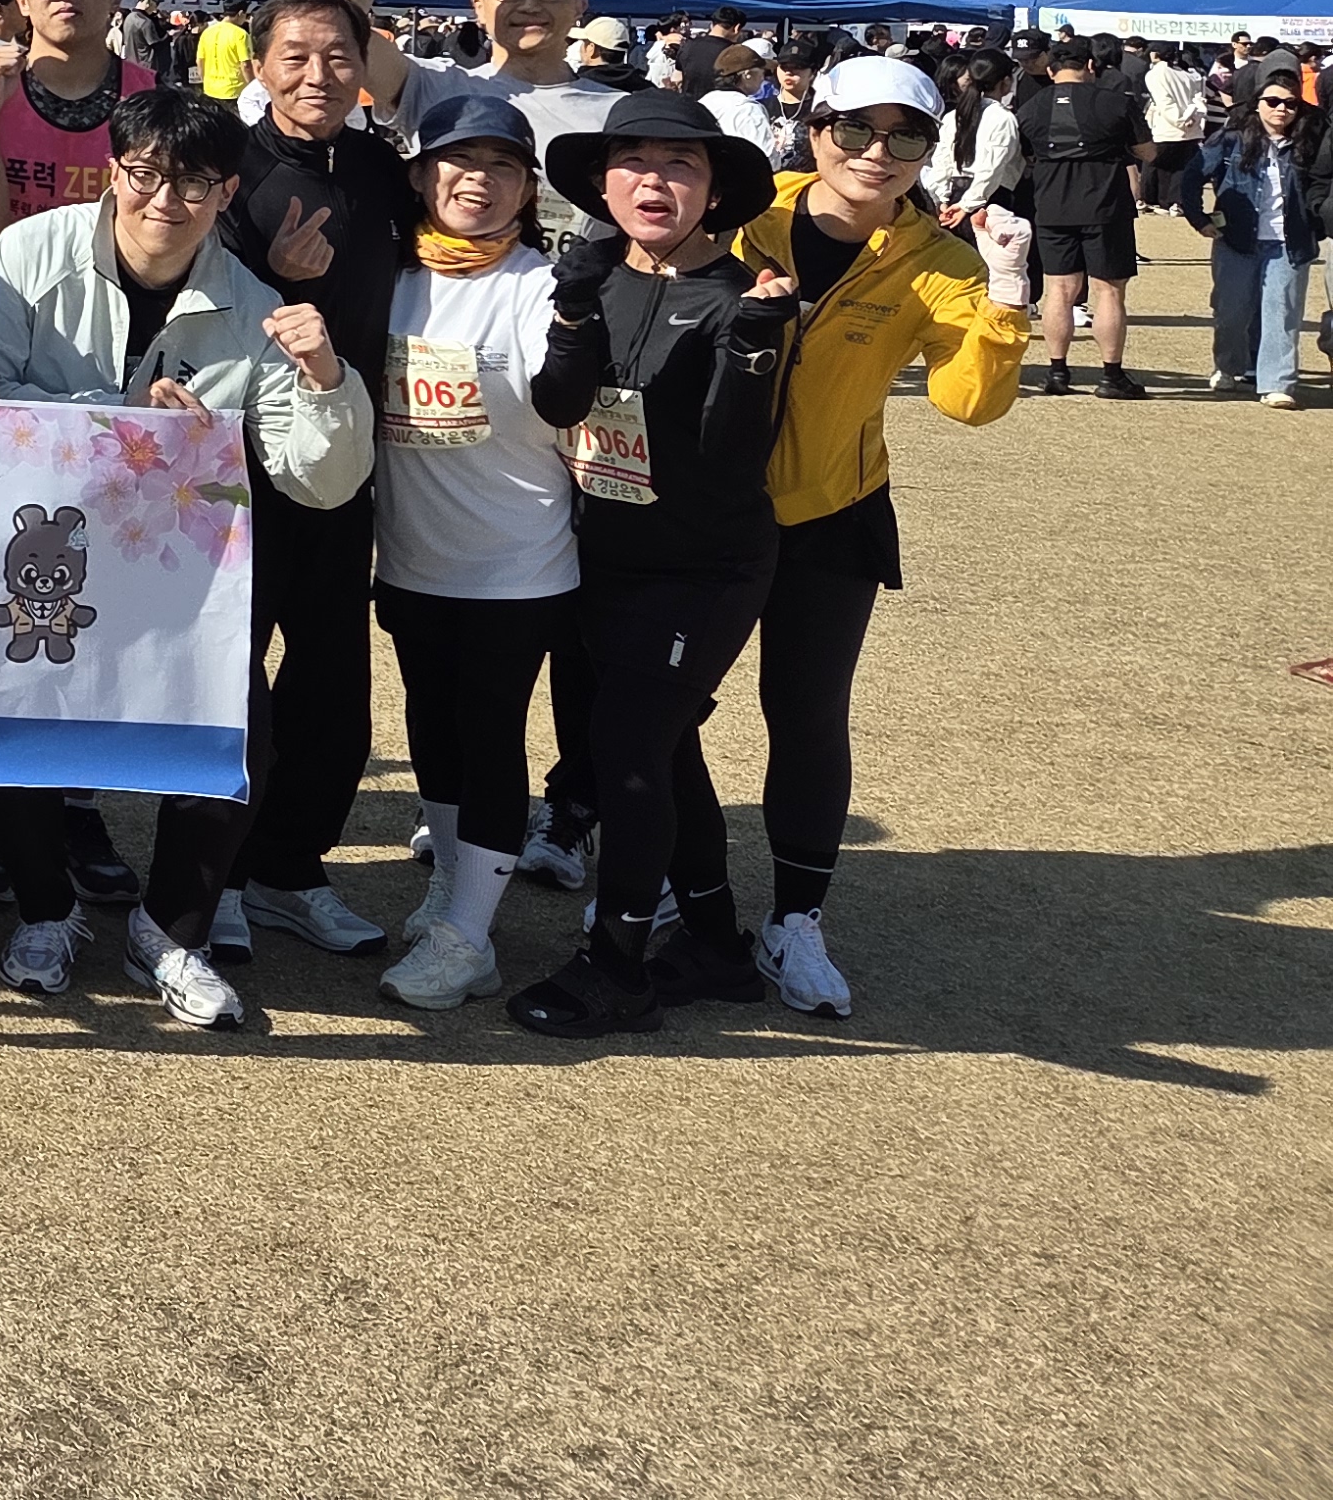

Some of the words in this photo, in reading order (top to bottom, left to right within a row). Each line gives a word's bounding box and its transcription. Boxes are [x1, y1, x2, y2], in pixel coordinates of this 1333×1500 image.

[5, 156, 57, 197] 폭력
[416, 429, 478, 446] 경남은행
[566, 422, 648, 464] 11064
[597, 477, 644, 502] 경남은행
